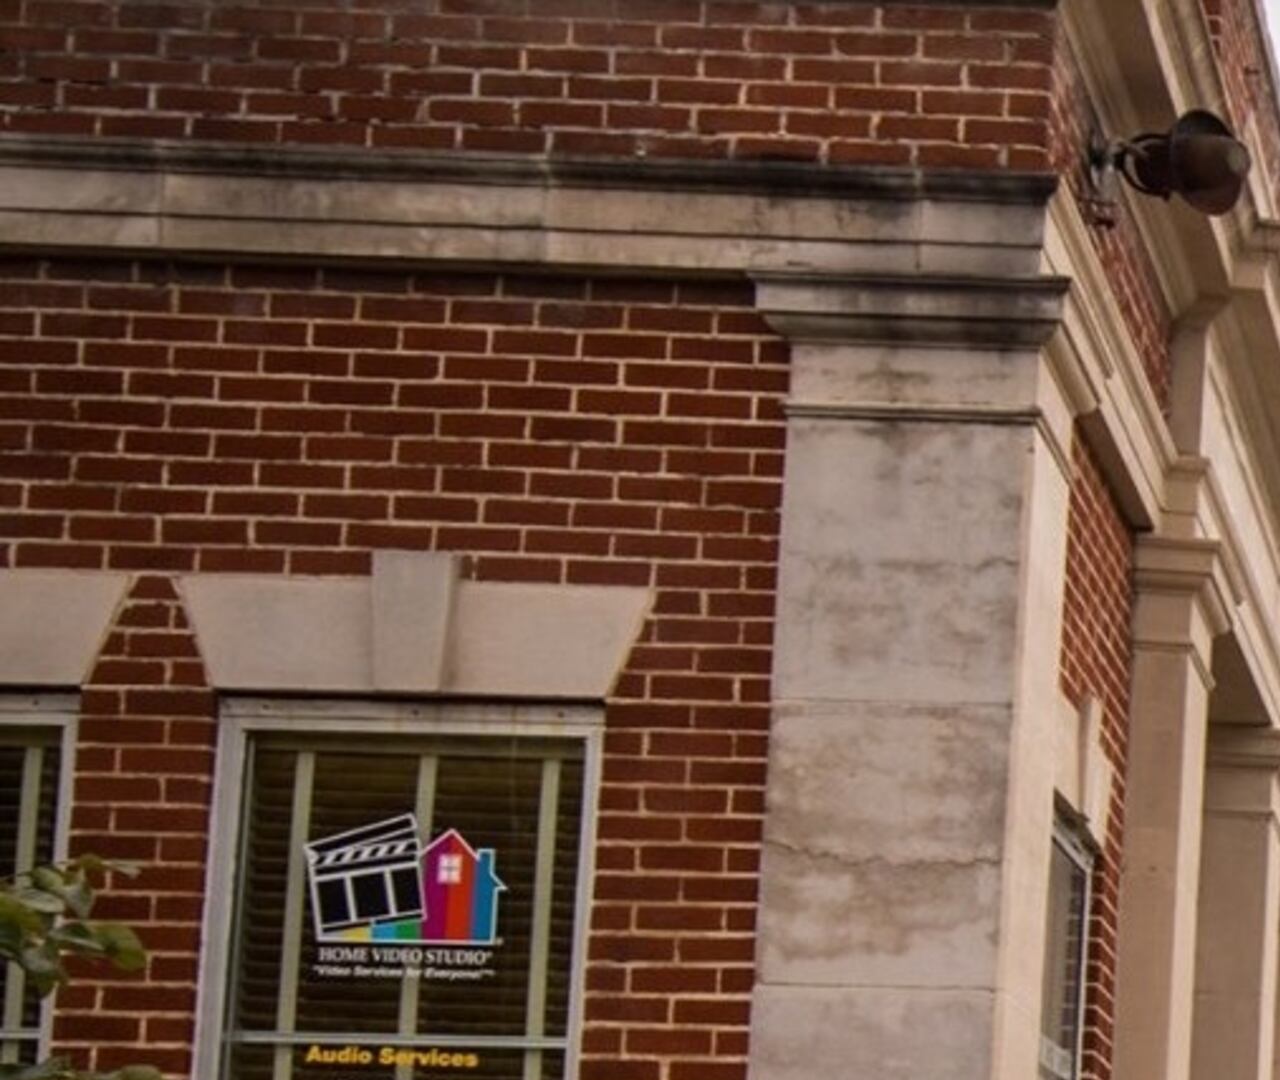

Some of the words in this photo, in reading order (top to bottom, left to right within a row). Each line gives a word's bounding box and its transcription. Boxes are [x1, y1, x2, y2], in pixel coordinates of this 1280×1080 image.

[319, 947, 368, 962] HOME
[372, 948, 423, 963] VIDEO
[306, 1045, 373, 1064] Audio
[379, 1048, 480, 1067] Services
